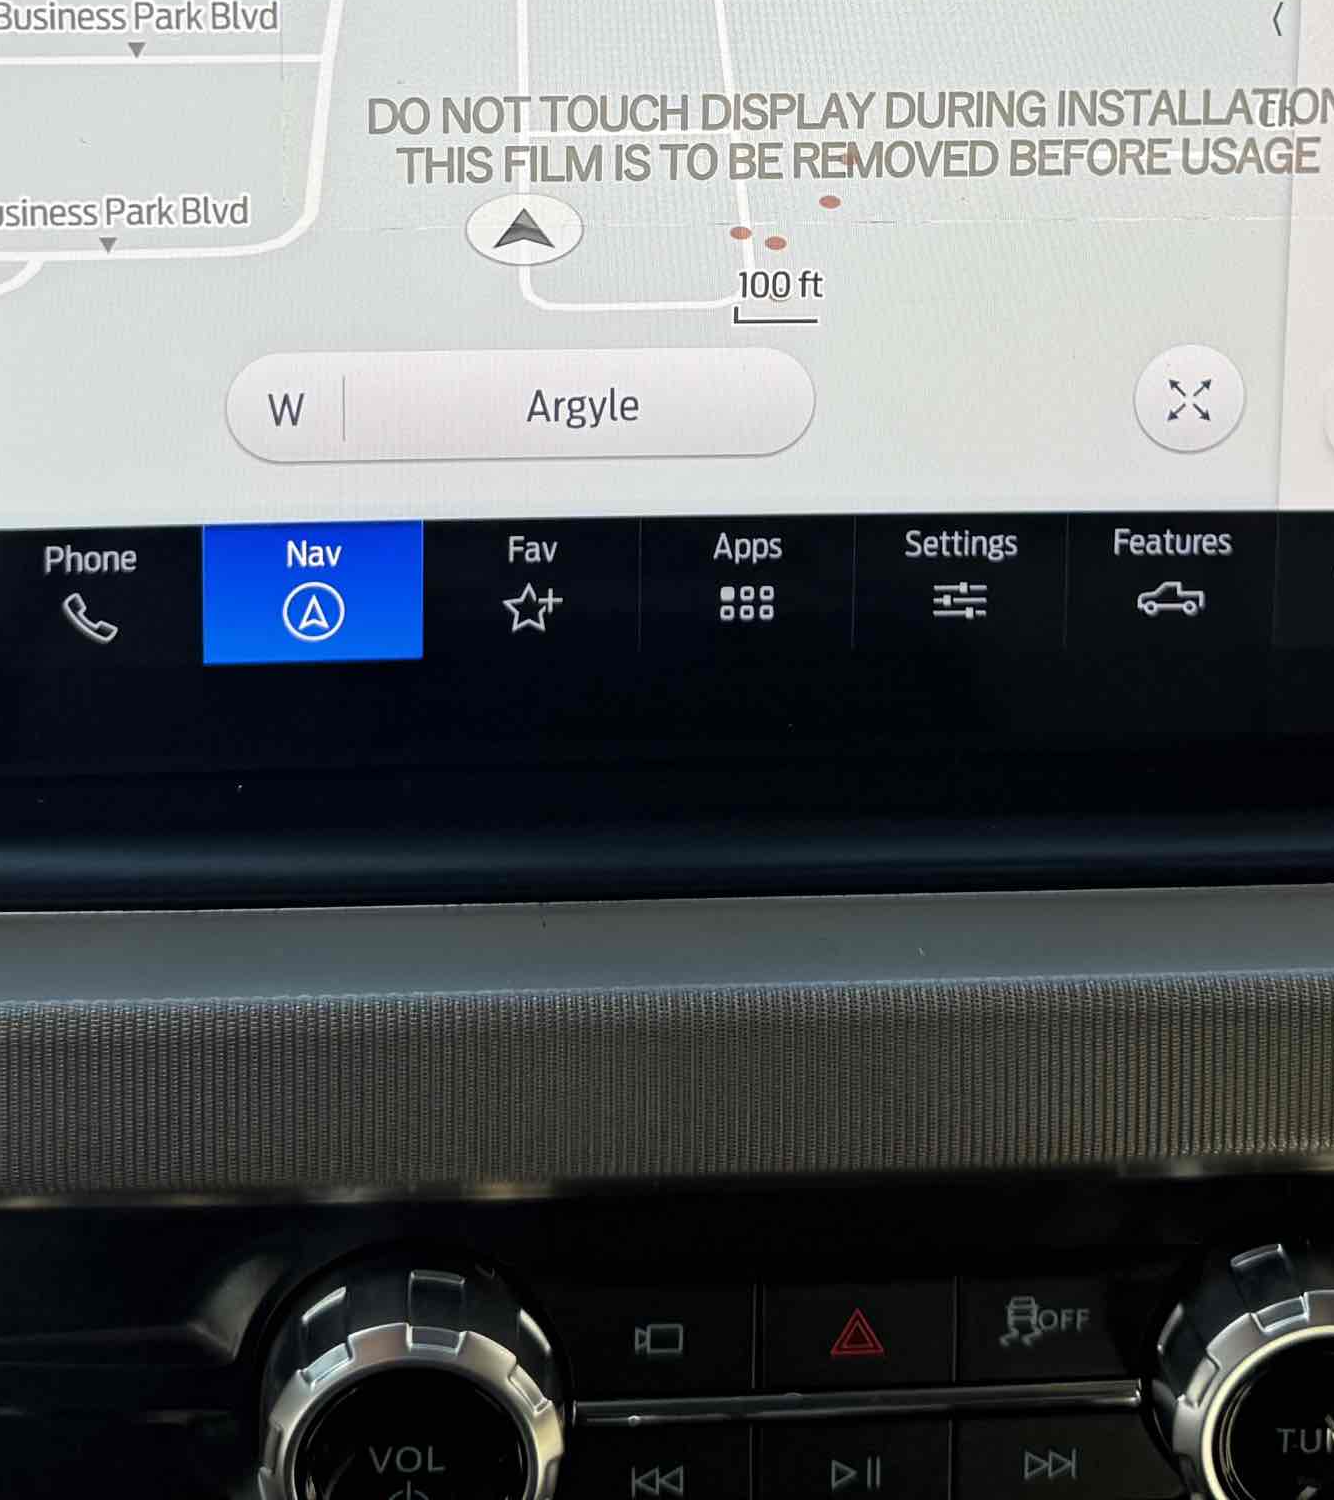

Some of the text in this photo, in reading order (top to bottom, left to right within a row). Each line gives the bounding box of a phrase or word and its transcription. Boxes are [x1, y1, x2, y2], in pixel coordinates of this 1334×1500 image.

[134, 2, 204, 31] Park
[209, 1, 280, 32] Blvd
[367, 96, 431, 136] DO
[441, 95, 532, 134] NOT
[539, 93, 689, 133] TOUCH
[701, 91, 877, 131] DISPLAY
[885, 89, 1047, 129] DURING
[395, 136, 1322, 185] THIS FILM IS TO BE REMOVED BEFORE USAGE
[105, 196, 175, 226] Park
[181, 195, 249, 225] Blvd
[738, 270, 823, 299] 100 ft
[267, 393, 305, 427] W
[526, 387, 640, 430] Argyle
[286, 539, 342, 568] Nav
[507, 533, 558, 564] Fav
[712, 530, 783, 566] Apps
[904, 526, 1019, 562] Settings
[1112, 526, 1232, 558] Features
[43, 544, 138, 575] Phone
[1038, 1306, 1092, 1334] OFF
[369, 1446, 446, 1474] VOL
